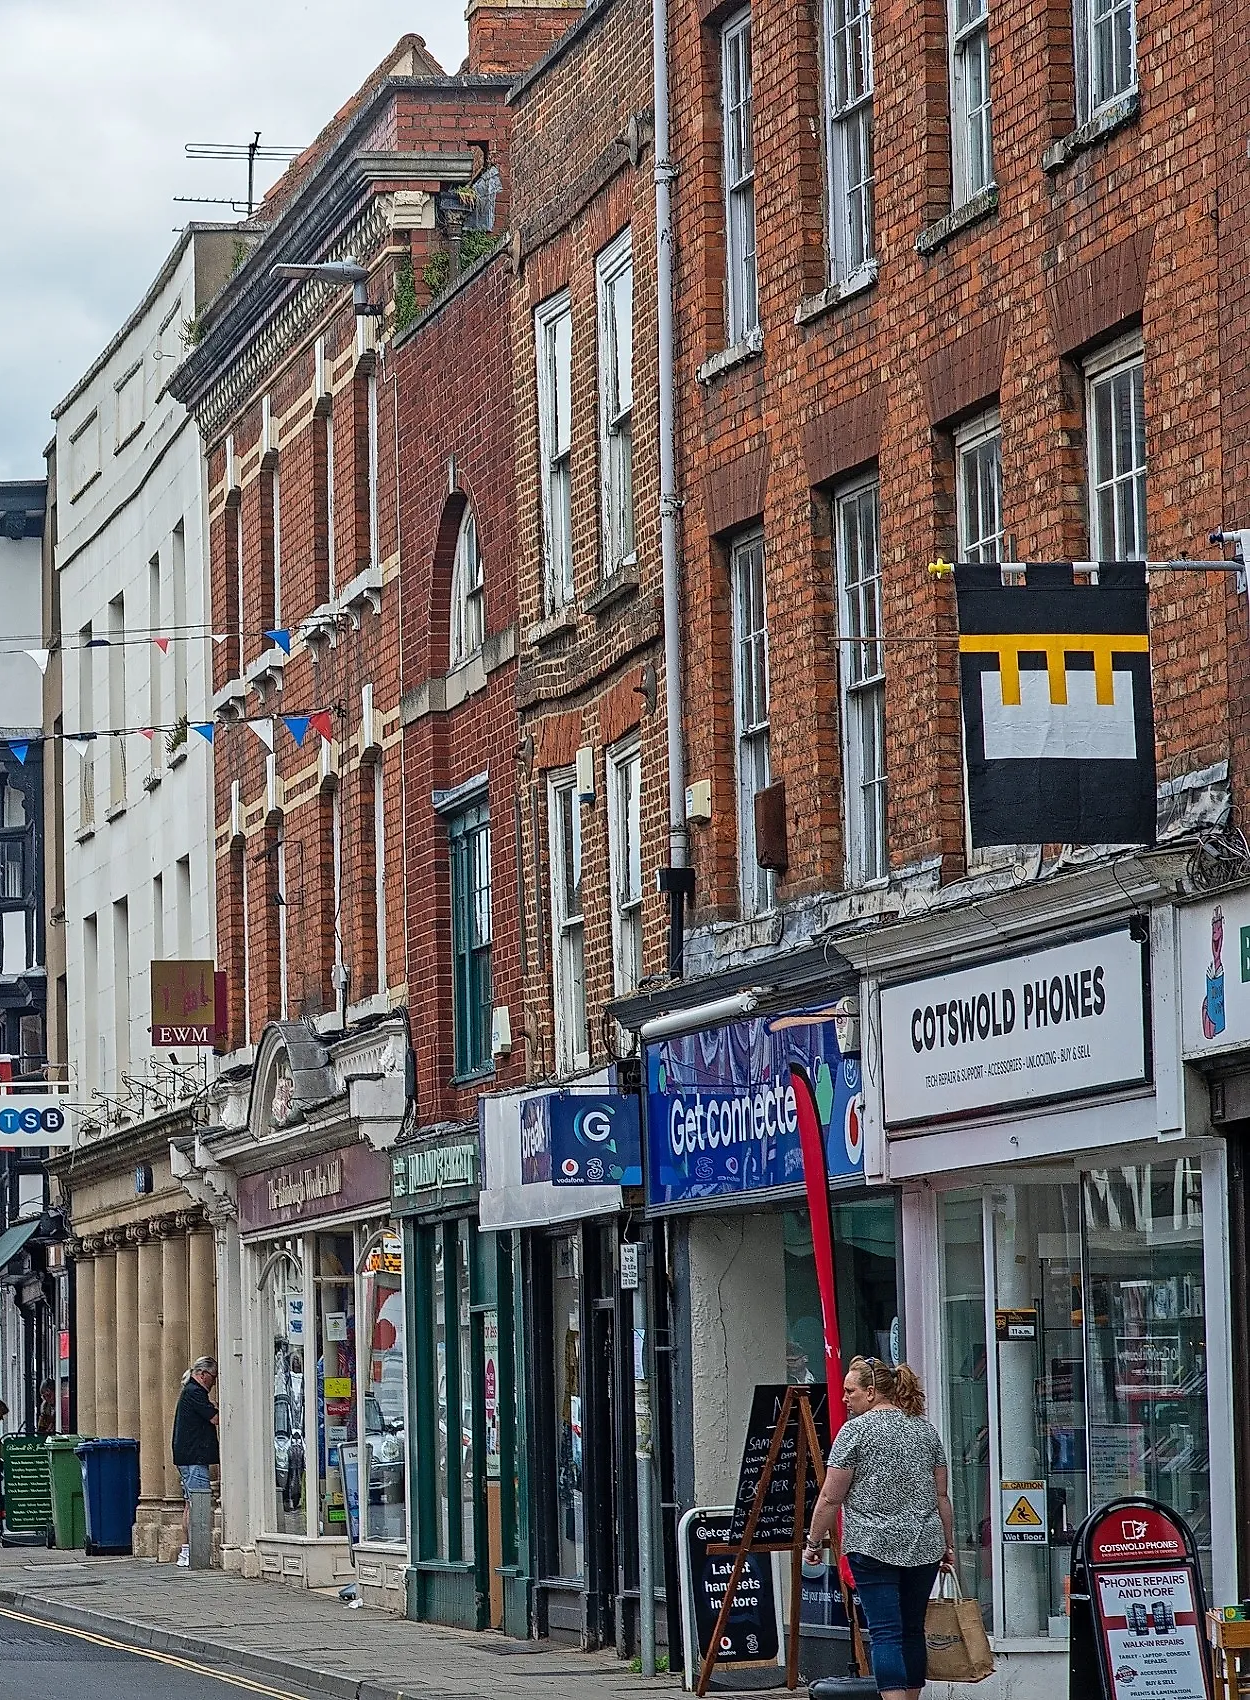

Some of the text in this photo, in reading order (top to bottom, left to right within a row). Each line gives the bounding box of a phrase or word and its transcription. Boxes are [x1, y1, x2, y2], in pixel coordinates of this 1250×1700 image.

[911, 964, 1107, 1054] COTSWOLD PHONES
[159, 1026, 210, 1043] EWM
[925, 1073, 938, 1089] TECH
[938, 1069, 957, 1086] REPAIR
[961, 1064, 984, 1083] SUPPORT
[987, 1057, 1023, 1077] ACCESSORIES
[1026, 1050, 1057, 1070] UNLOCKING
[1060, 1046, 1073, 1063] BUY
[1077, 1044, 1091, 1059] SELL
[3, 1111, 60, 1129] TSB
[748, 1436, 794, 1452] SAMNG
[770, 1480, 789, 1494] PER
[1099, 1540, 1178, 1552] COTSWOLD PHONES
[712, 1562, 750, 1575] Latt
[1104, 1574, 1185, 1588] PHONE REPAIRS
[1118, 1587, 1175, 1598] AND MORE
[1122, 1638, 1184, 1648] WALK-IN REPAIRS
